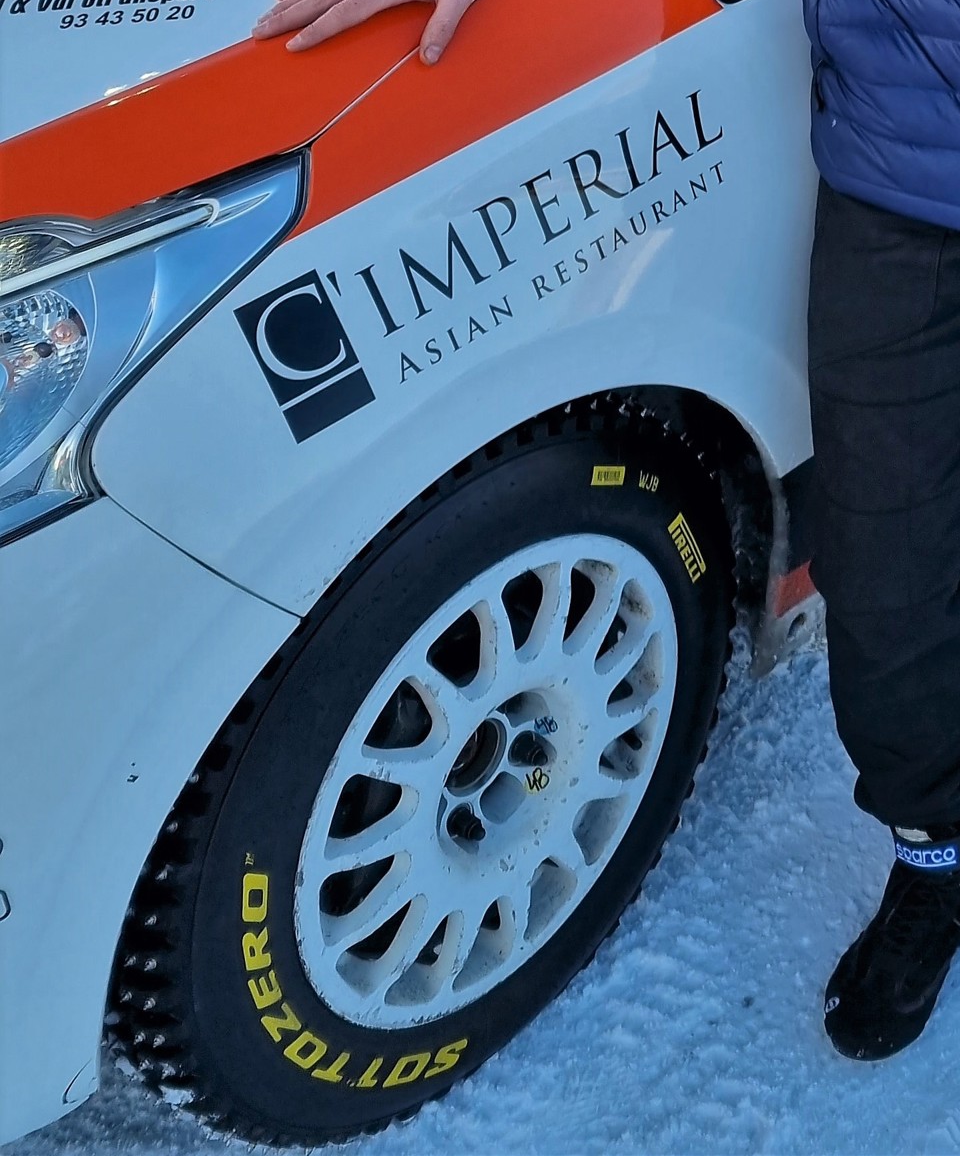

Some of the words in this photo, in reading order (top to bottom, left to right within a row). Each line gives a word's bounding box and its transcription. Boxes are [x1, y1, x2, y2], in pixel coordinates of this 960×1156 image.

[59, 14, 88, 29] 93
[95, 11, 124, 25] 43
[131, 8, 160, 23] 50
[166, 5, 195, 20] 20
[354, 89, 724, 339] IMPERIAL
[400, 296, 513, 384] ASIAN
[531, 161, 725, 299] RESTAURANT
[668, 512, 707, 584] PIRELLI
[896, 843, 957, 868] sparco
[242, 873, 468, 1088] SOTTOZERO
